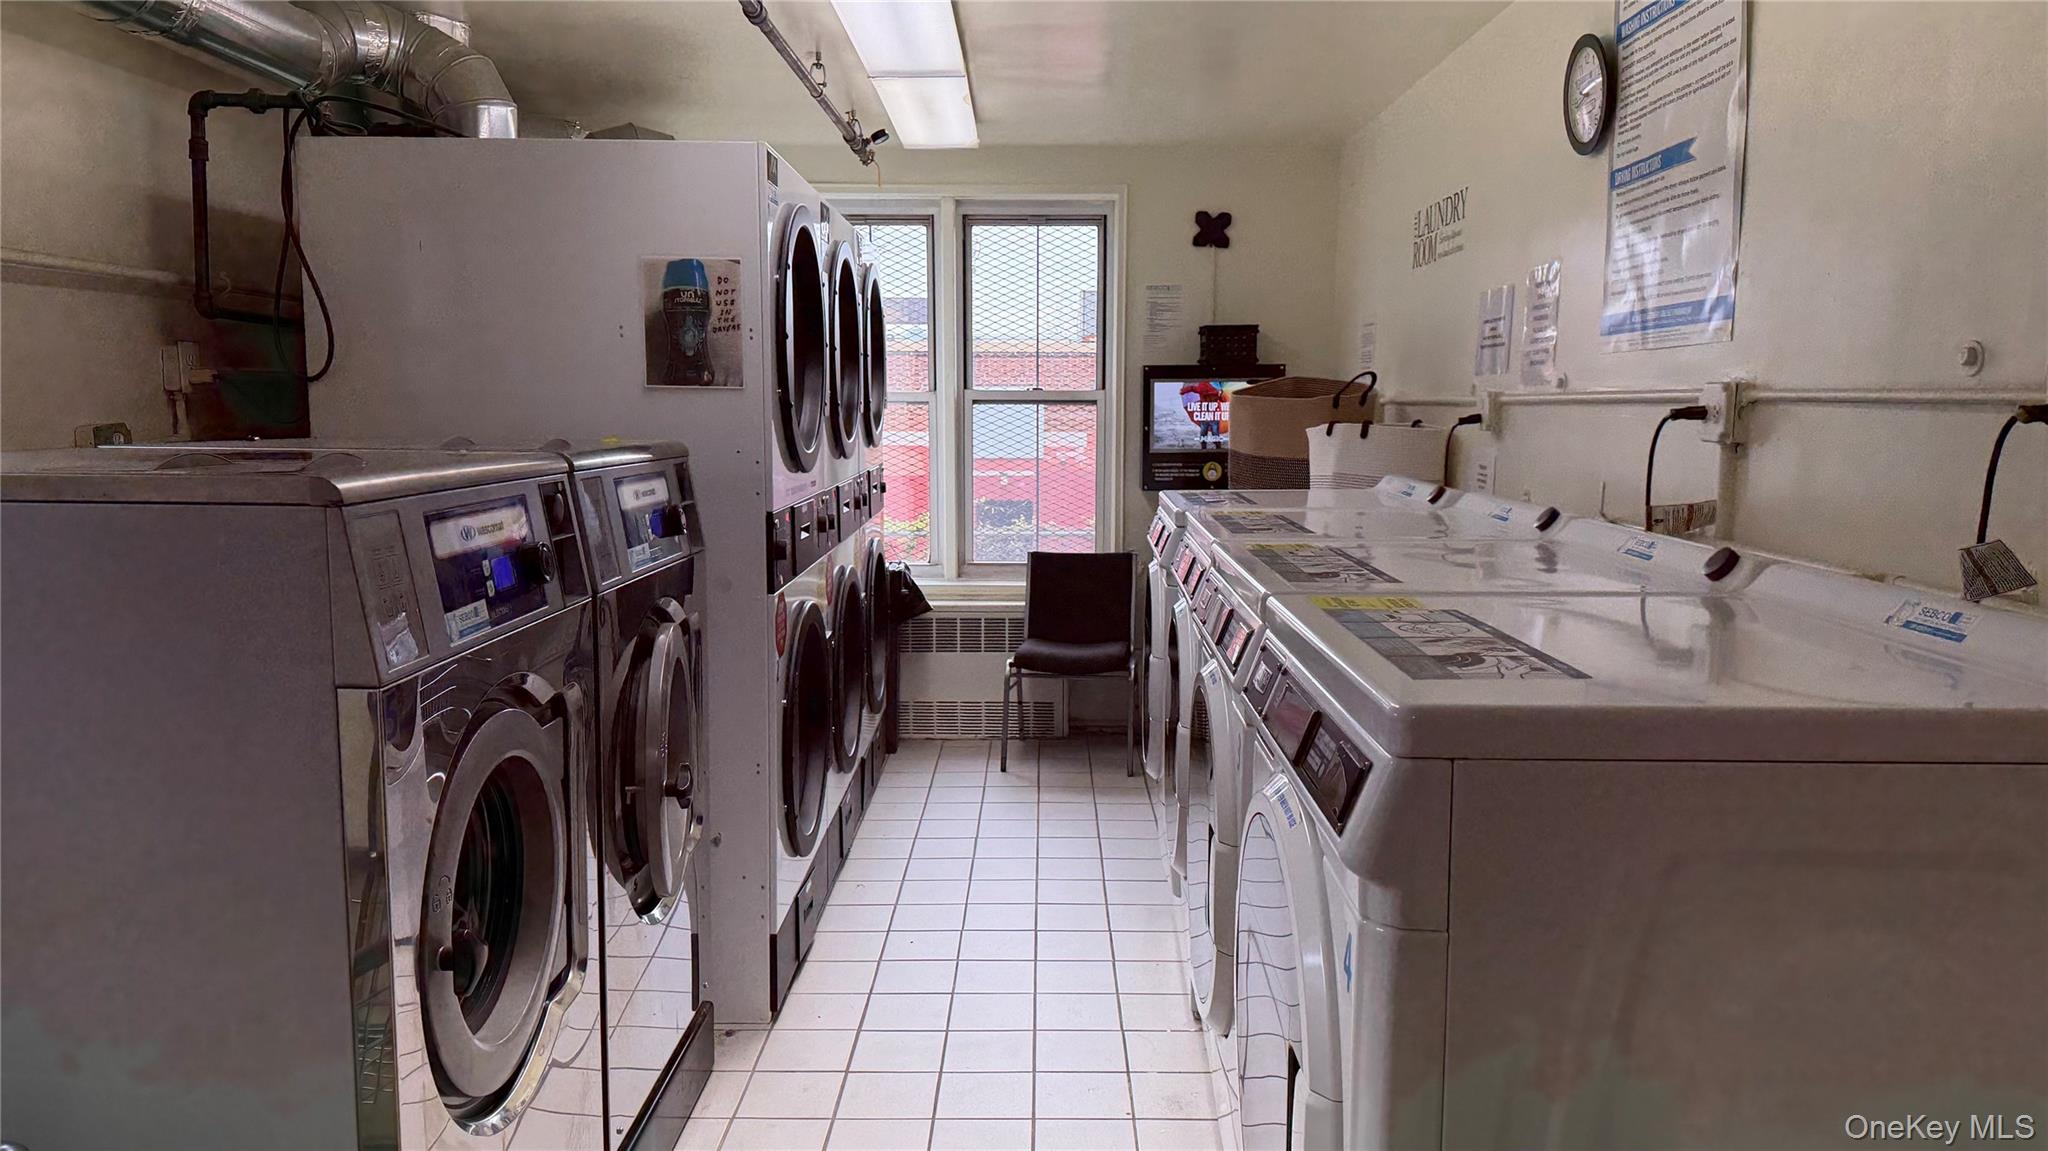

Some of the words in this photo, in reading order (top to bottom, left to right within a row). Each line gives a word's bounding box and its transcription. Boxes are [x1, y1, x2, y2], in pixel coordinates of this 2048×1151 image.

[1417, 186, 1469, 238] LAUNDRY
[1412, 232, 1438, 270] ROOM
[717, 276, 729, 285] DO
[715, 288, 736, 297] NOT
[715, 298, 735, 307] USE
[1187, 402, 1201, 412] LIVE
[1201, 402, 1208, 412] IT
[1193, 412, 1214, 421] CLEAN
[1214, 412, 1221, 421] IT
[1918, 606, 1952, 622] SEBCO
[1343, 931, 1353, 993] 4
